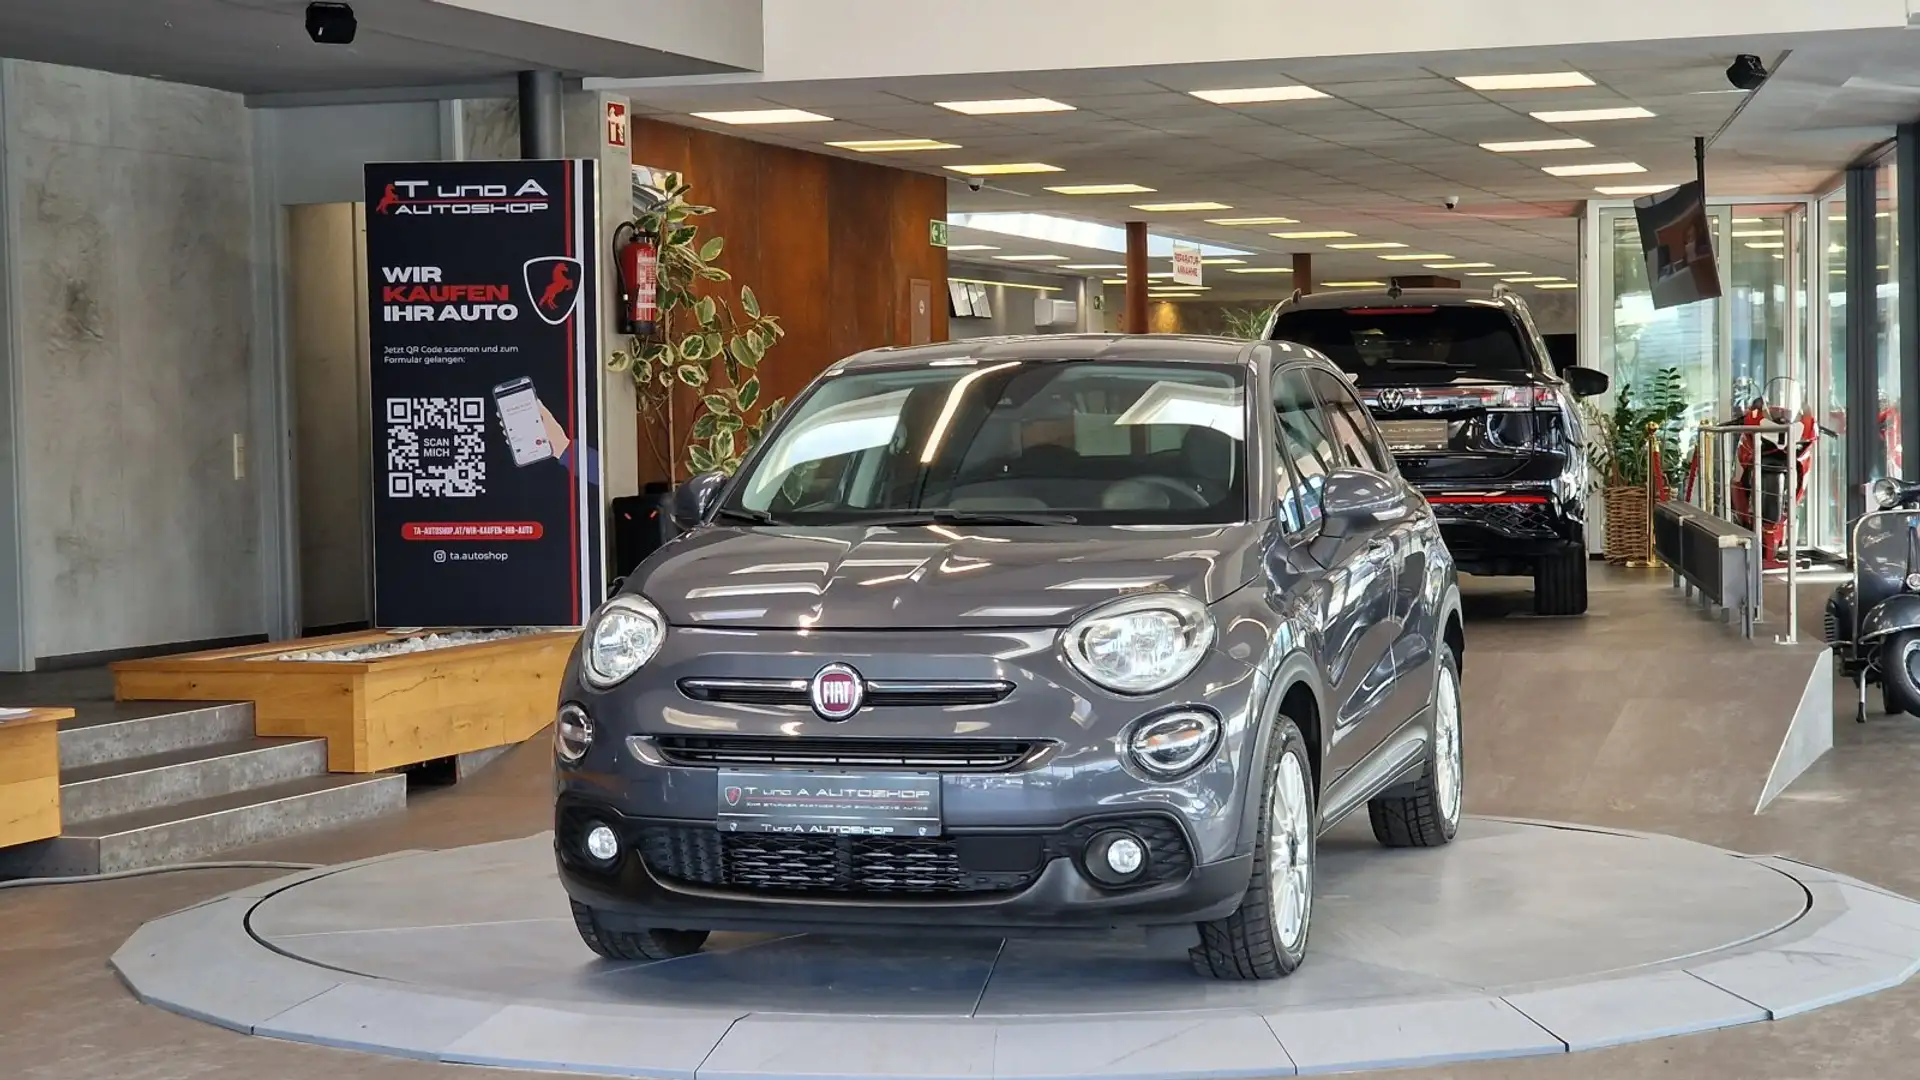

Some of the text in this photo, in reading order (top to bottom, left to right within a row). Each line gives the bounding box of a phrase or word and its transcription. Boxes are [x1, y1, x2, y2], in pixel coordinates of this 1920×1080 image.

[394, 180, 429, 198] T
[514, 179, 548, 197] A
[395, 203, 548, 215] AUTOSHOP
[382, 266, 442, 283] WIR
[383, 285, 509, 302] KAUFEN
[383, 304, 518, 322] IHR AUTO
[384, 346, 404, 354] Jetzt
[406, 346, 419, 354] QR
[481, 345, 498, 353] und
[384, 355, 466, 365] Formular gelangen:
[423, 437, 450, 447] SCAN
[423, 447, 450, 458] MICH
[449, 551, 509, 561] ta.autoshop
[823, 681, 851, 704] FIAT
[744, 787, 757, 795] T
[797, 788, 809, 796] A
[816, 788, 930, 799] AUTOSHOP
[809, 825, 894, 835] AUTOSHOP
